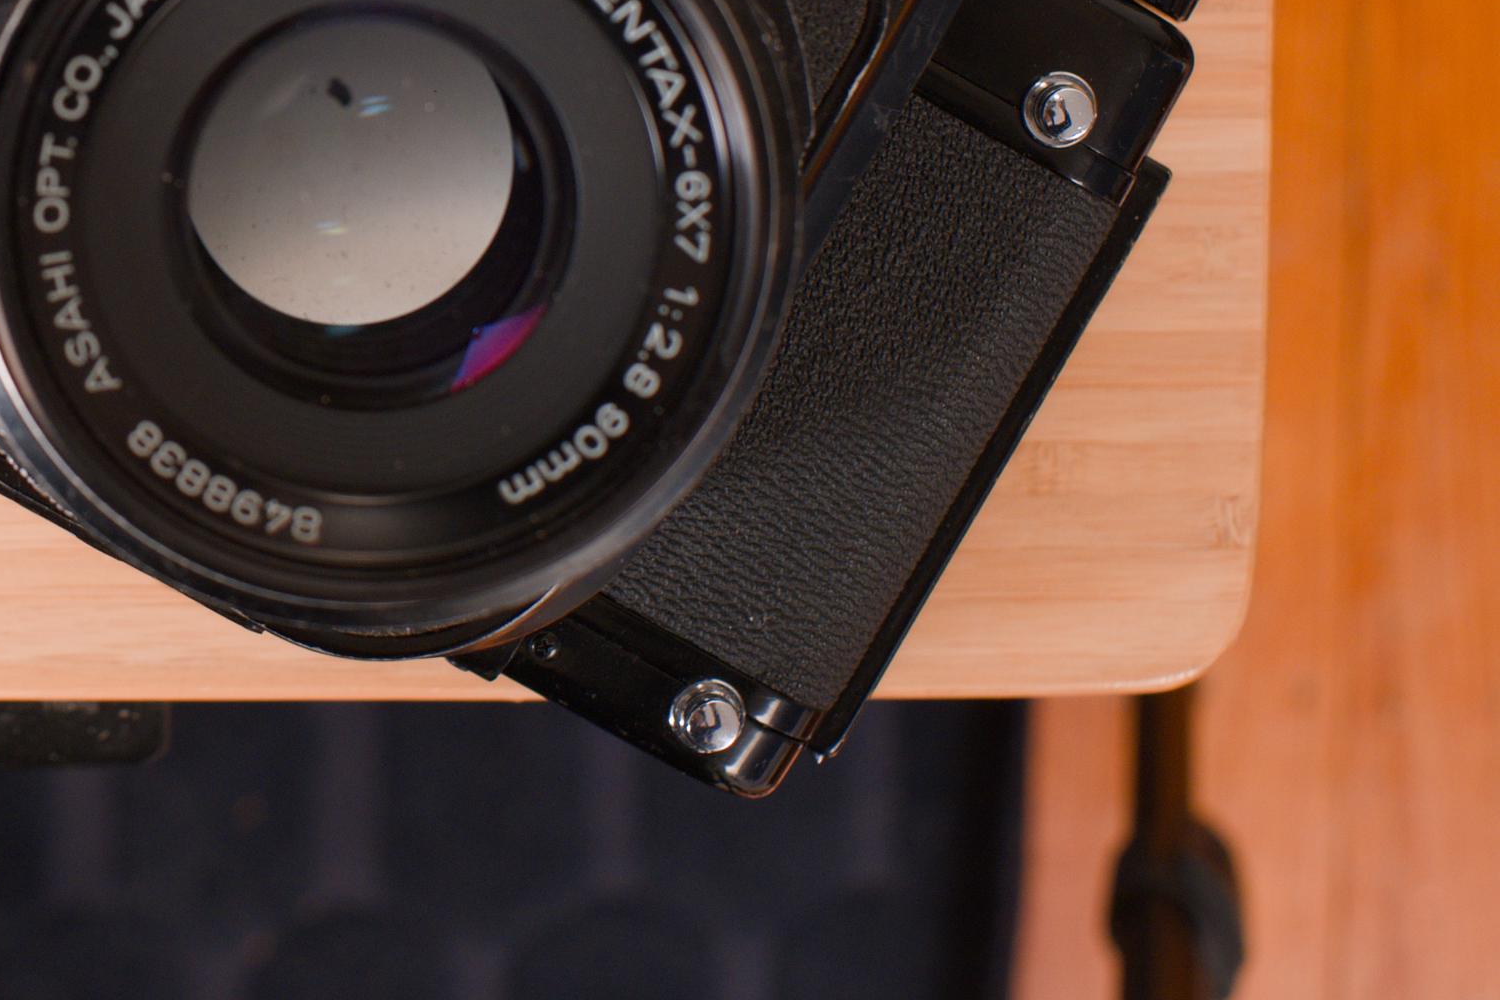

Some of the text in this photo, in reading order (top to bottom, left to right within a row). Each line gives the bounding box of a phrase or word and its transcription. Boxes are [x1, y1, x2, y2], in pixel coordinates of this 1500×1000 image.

[32, 131, 79, 234] OPT.
[38, 249, 124, 393] ASAHI
[622, 285, 700, 399] 1:2.8
[497, 401, 631, 506] 90mm
